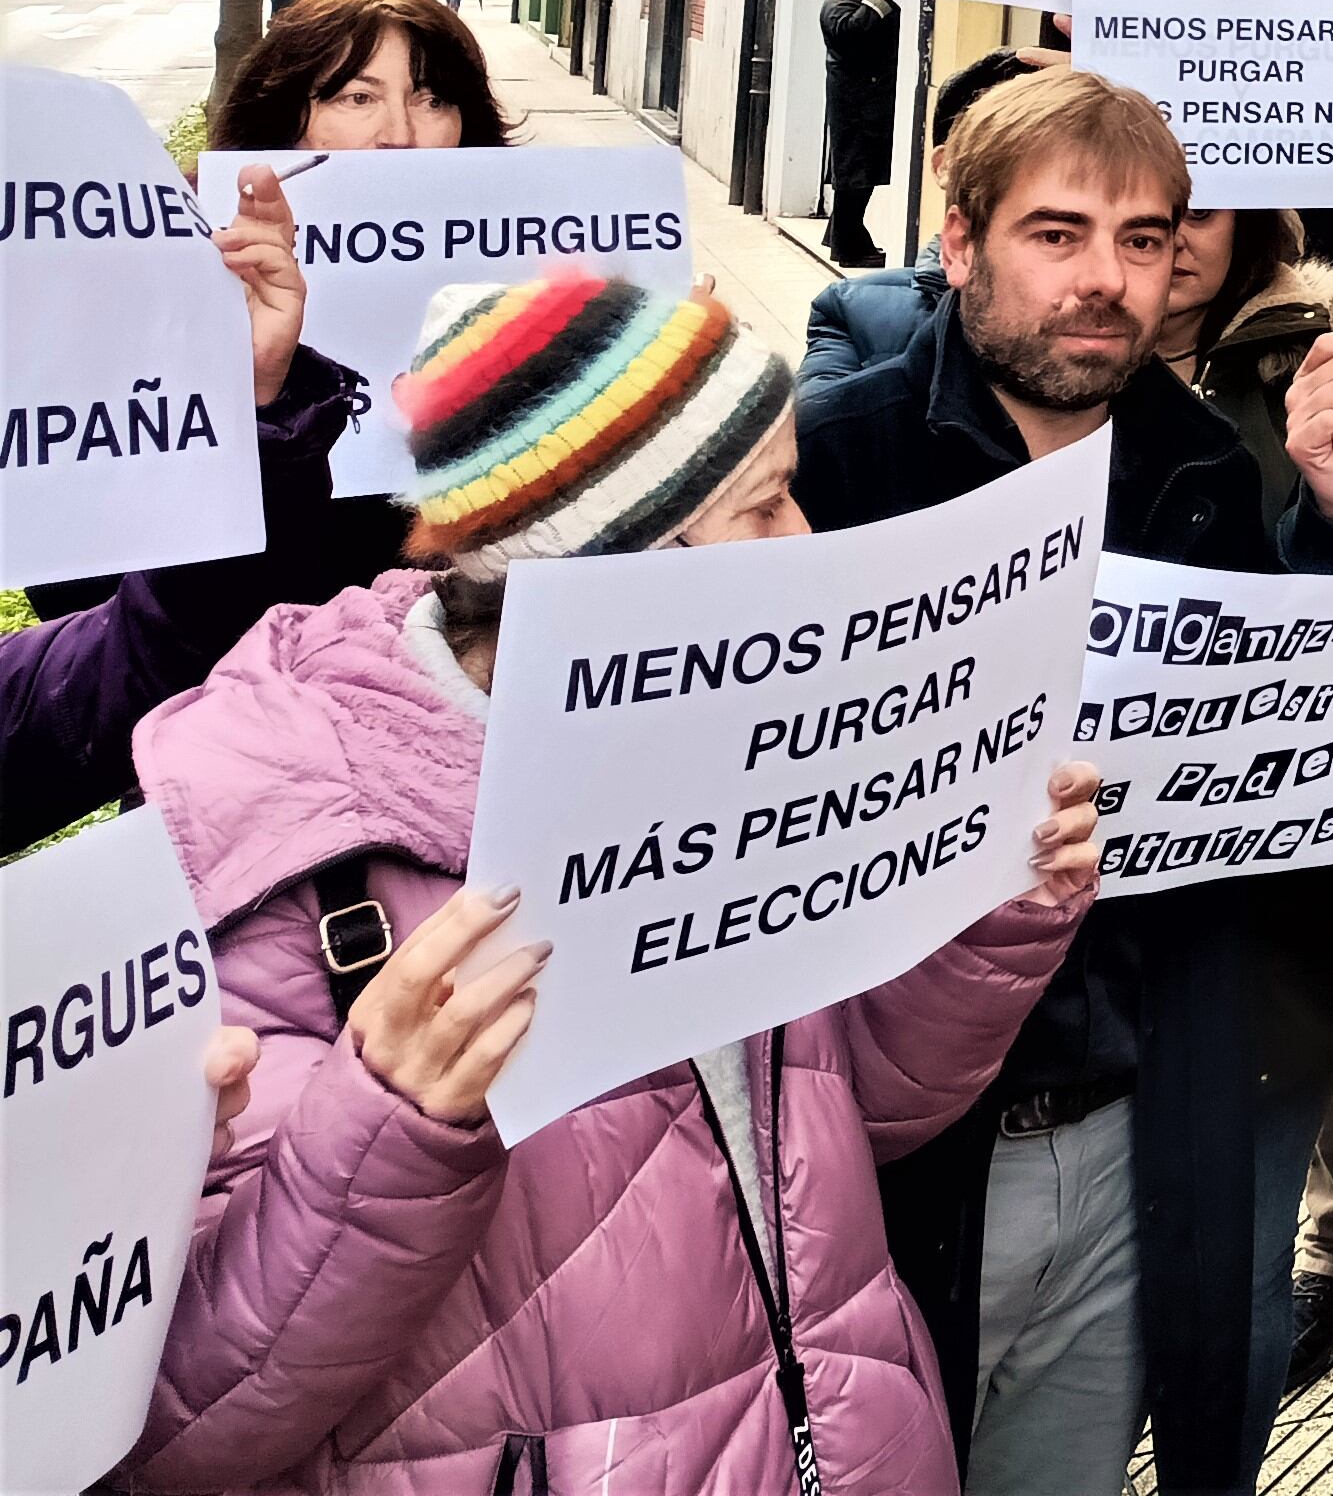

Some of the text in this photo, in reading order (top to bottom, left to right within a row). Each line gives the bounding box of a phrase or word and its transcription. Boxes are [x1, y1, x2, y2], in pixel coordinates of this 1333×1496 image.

[1094, 16, 1206, 39] MENOS
[1178, 60, 1303, 82] PURGAR
[1183, 101, 1304, 124] PENSAR
[1183, 143, 1333, 166] ECCIONES
[0, 180, 211, 242] RGUES
[444, 213, 682, 260] PURGUES
[564, 516, 1084, 713] MENOS PENSAR EN
[744, 656, 976, 771] PURGAR
[559, 692, 1047, 905] MÁS PENSAR NES
[630, 804, 991, 974] ELECCIONES
